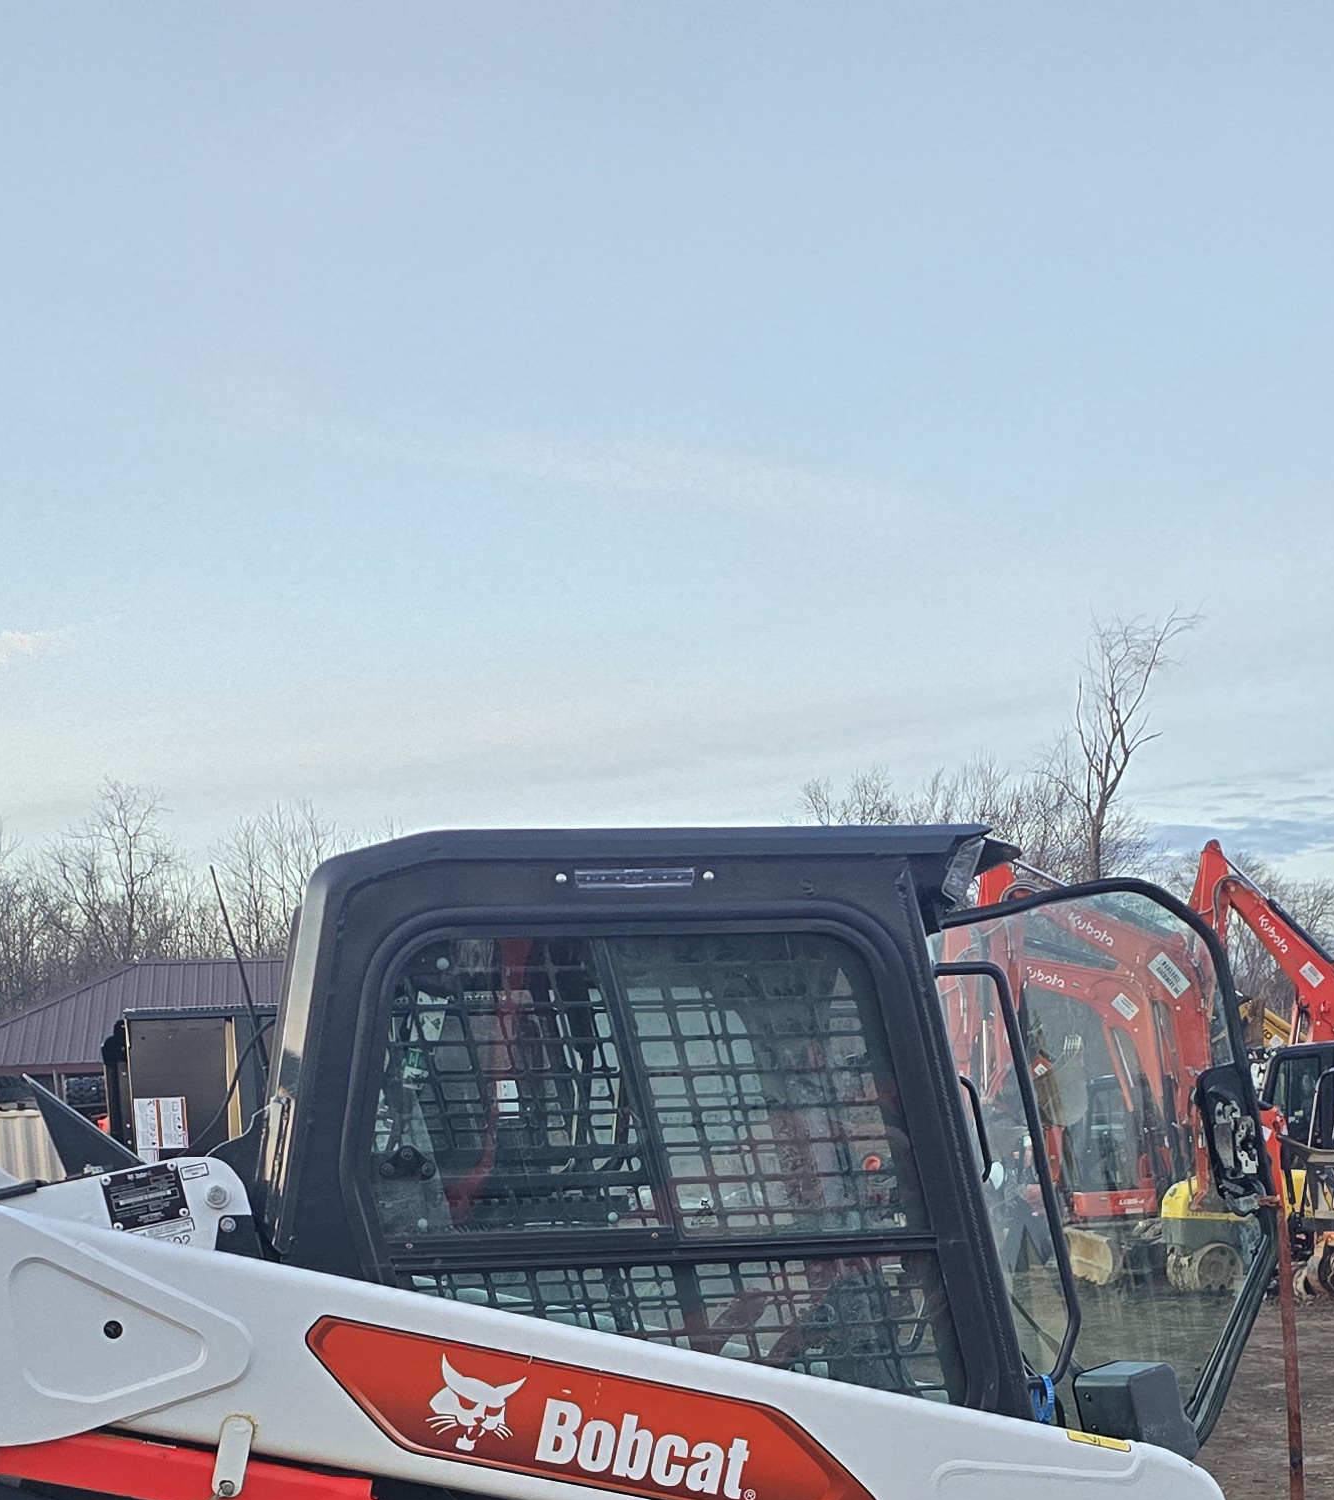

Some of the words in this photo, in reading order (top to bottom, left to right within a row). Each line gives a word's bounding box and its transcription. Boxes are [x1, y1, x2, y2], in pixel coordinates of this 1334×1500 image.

[1068, 912, 1114, 947] Kubota
[1259, 914, 1288, 953] Kubota
[535, 1398, 750, 1500] Bobcat
